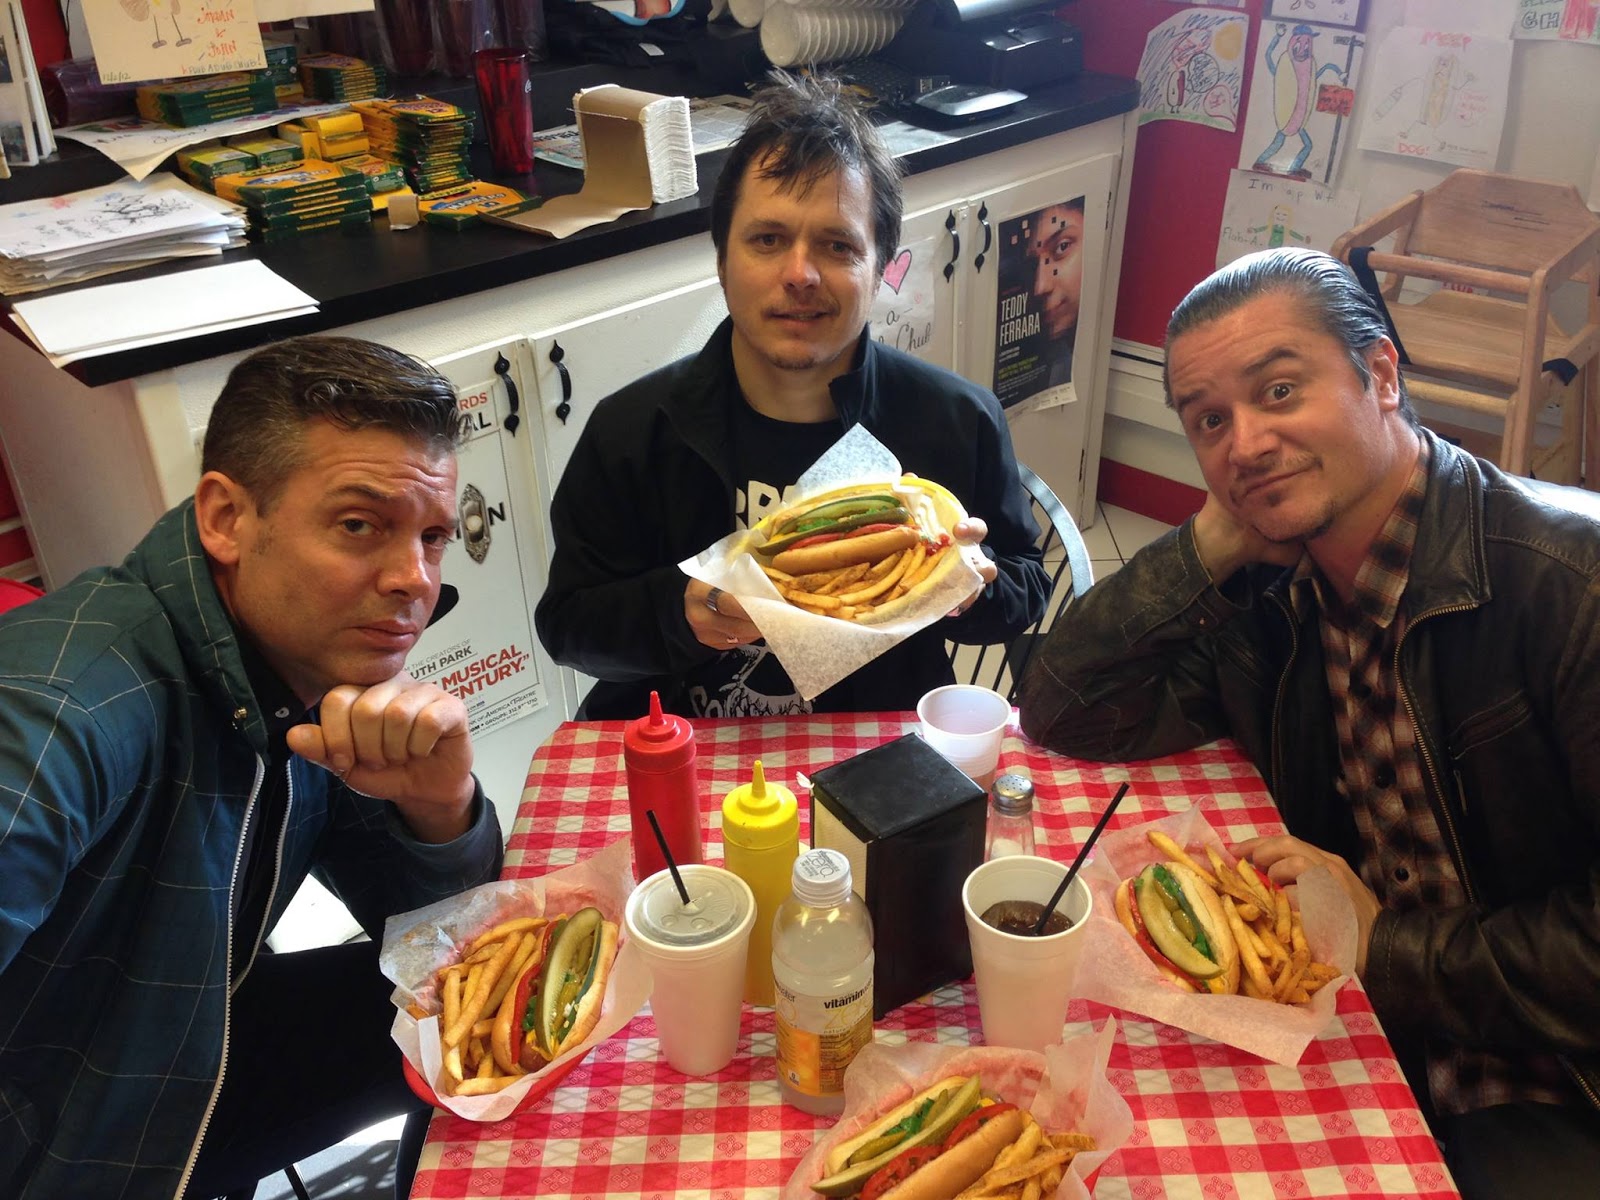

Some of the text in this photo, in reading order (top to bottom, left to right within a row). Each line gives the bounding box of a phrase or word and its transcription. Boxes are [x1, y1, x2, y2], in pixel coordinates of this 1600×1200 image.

[1001, 292, 1029, 323] TEDDY
[1000, 311, 1041, 347] FERRARA
[459, 391, 488, 411] RDS
[410, 645, 473, 680] UTH PARK
[411, 660, 425, 669] THE
[426, 644, 461, 663] CREATORS
[441, 644, 523, 691] MUSICAL
[448, 653, 530, 700] ENTURY.”
